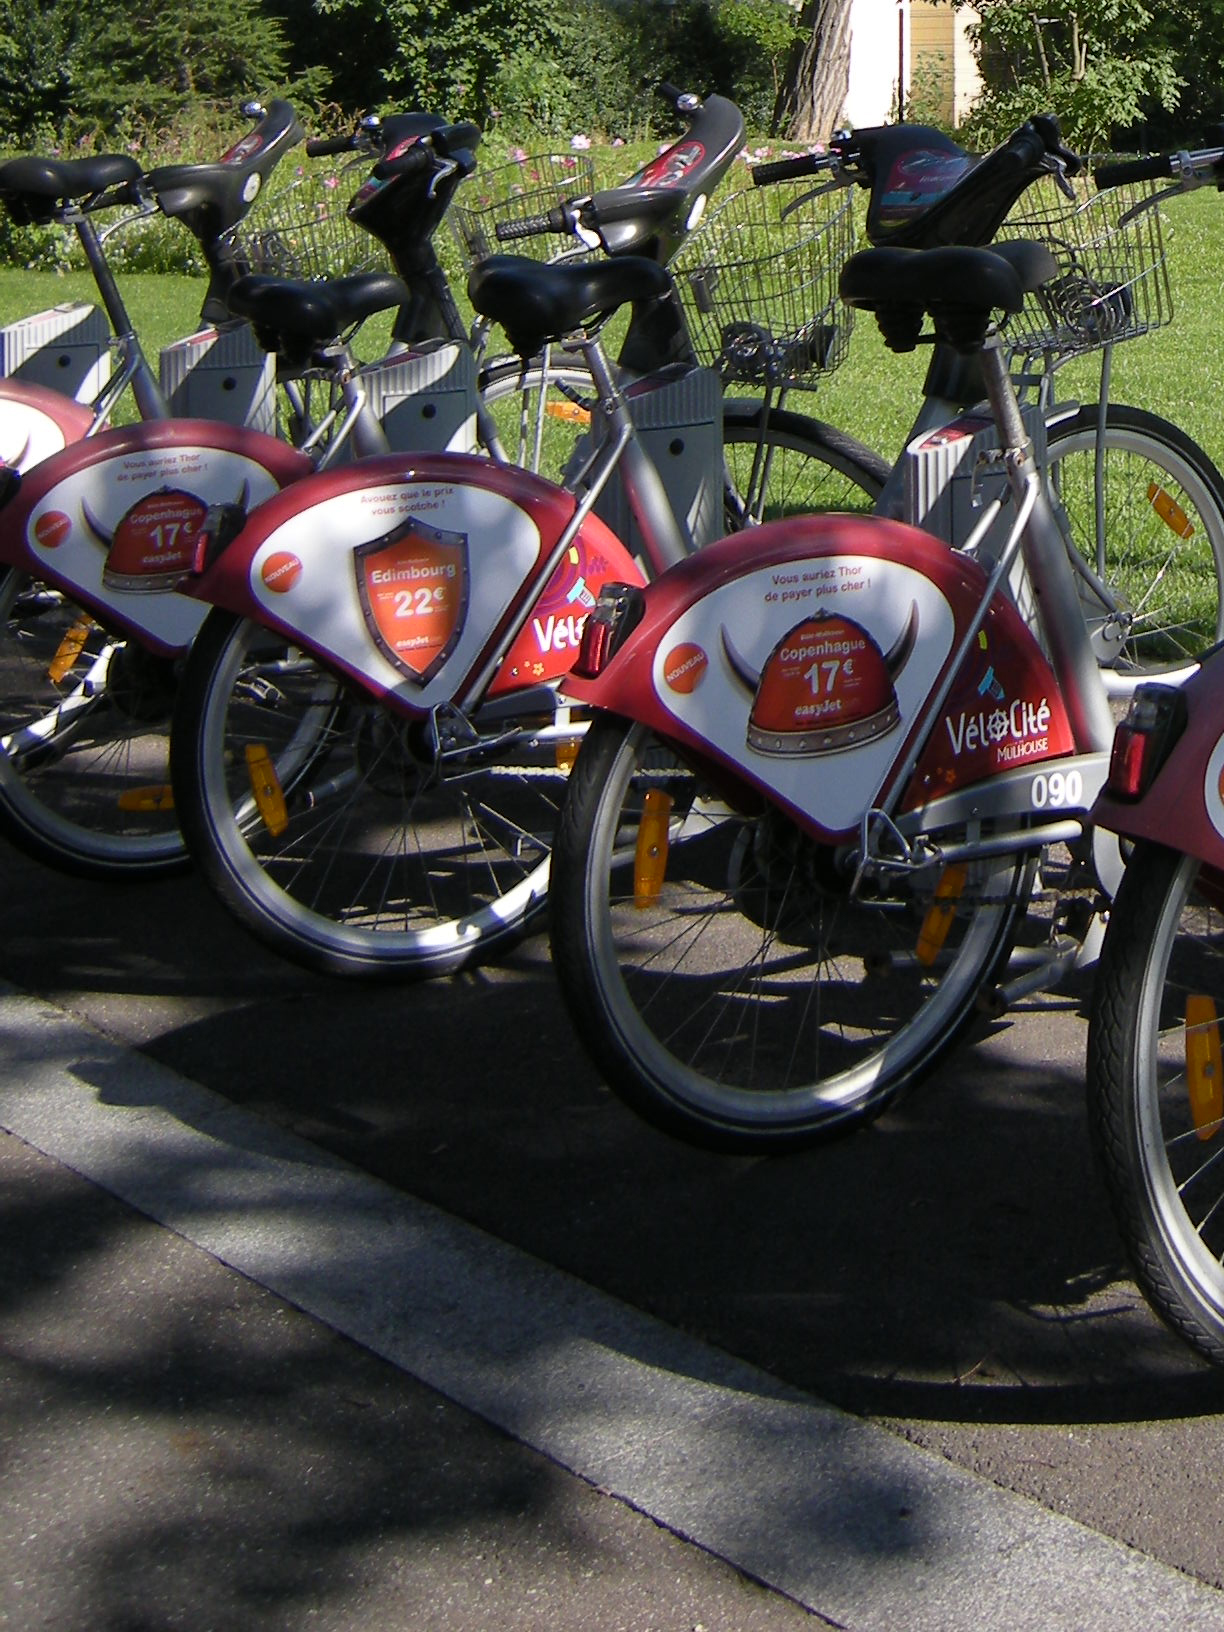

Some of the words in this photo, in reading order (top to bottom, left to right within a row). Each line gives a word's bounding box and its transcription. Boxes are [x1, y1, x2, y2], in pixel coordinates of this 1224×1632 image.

[360, 494, 398, 504] Avouez
[400, 490, 419, 501] que
[434, 487, 454, 498] prix
[371, 507, 396, 516] vous
[371, 564, 457, 584] Edimbourg
[772, 574, 799, 586] Vous
[802, 570, 836, 582] auriez
[838, 565, 863, 577] Thor
[764, 591, 778, 602] de
[781, 588, 812, 602] payer
[816, 585, 838, 598] plus
[841, 581, 865, 593] cher
[780, 638, 866, 662] Copenhague
[666, 652, 705, 683] NOUVEAU
[794, 699, 842, 717] easyJet
[997, 737, 1049, 763] MULHOUSE
[1031, 770, 1083, 808] 090
